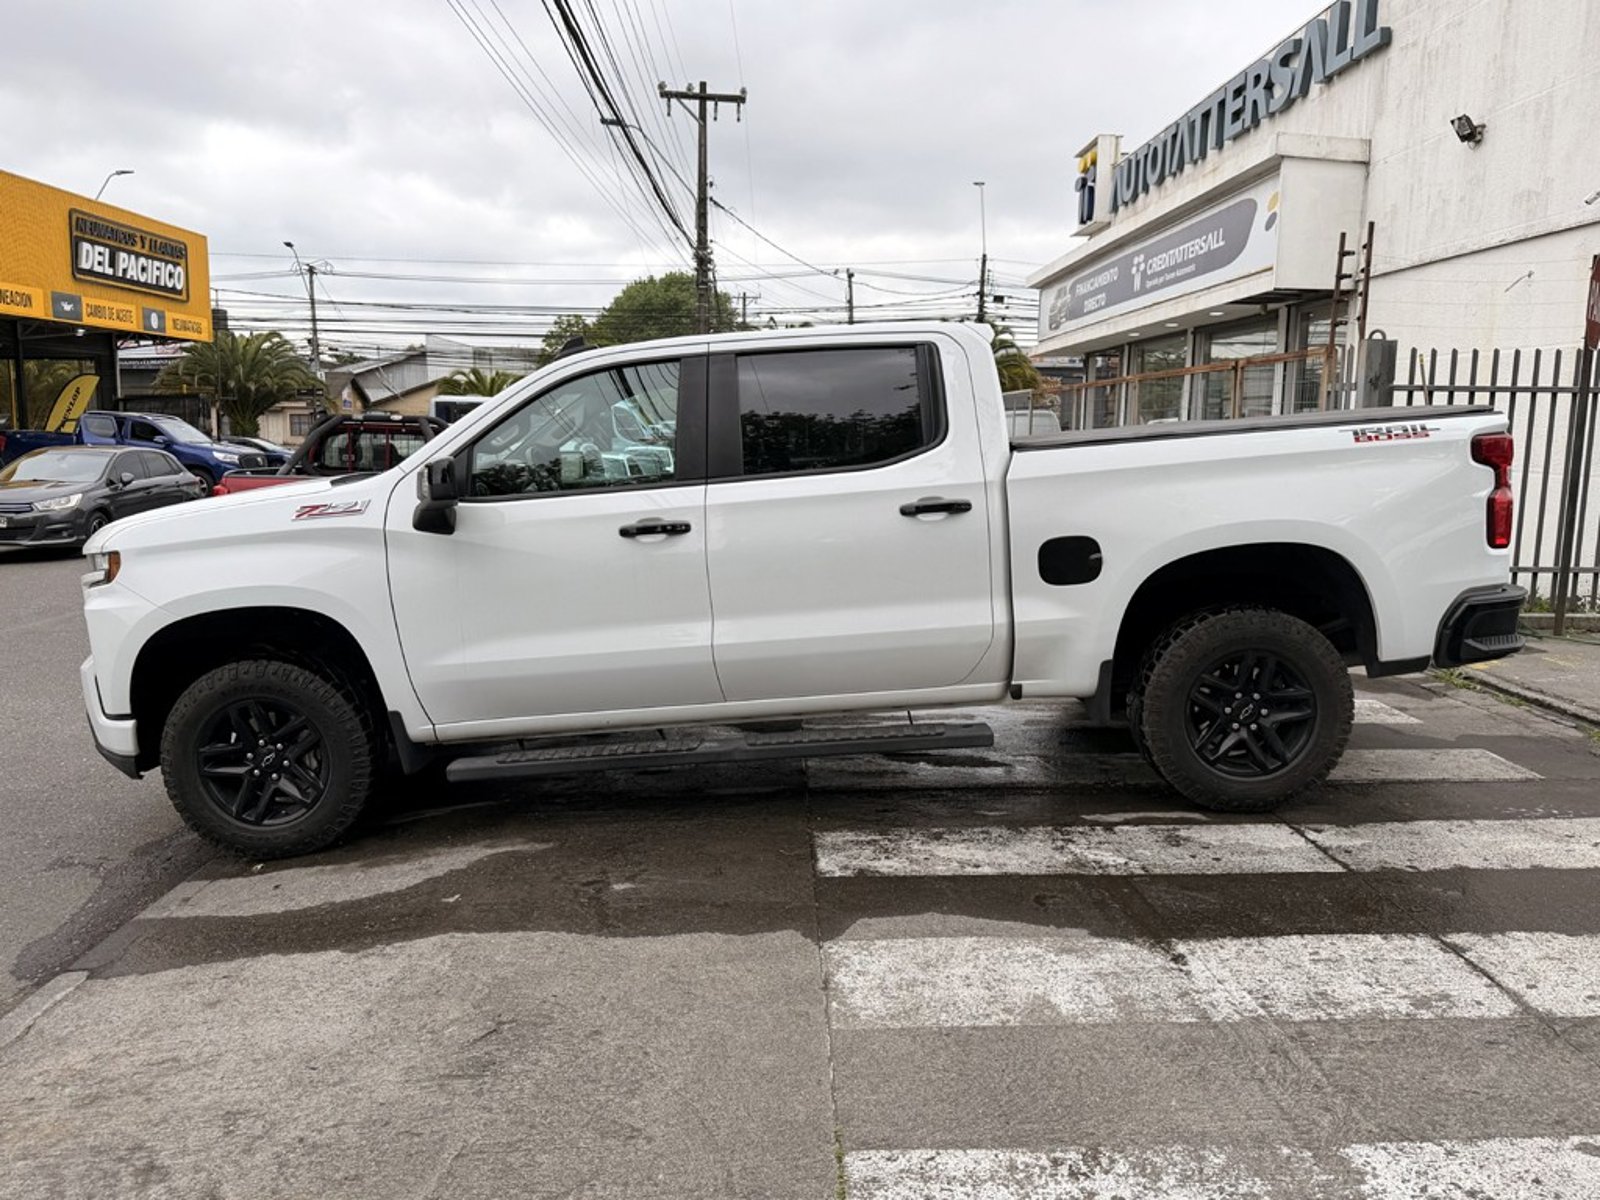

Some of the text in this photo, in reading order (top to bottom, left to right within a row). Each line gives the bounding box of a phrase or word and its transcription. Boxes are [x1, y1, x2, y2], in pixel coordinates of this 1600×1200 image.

[1109, 0, 1391, 214] AUTOTATTERSALL
[78, 241, 185, 290] DEL PACIFICO
[107, 306, 115, 322] DE
